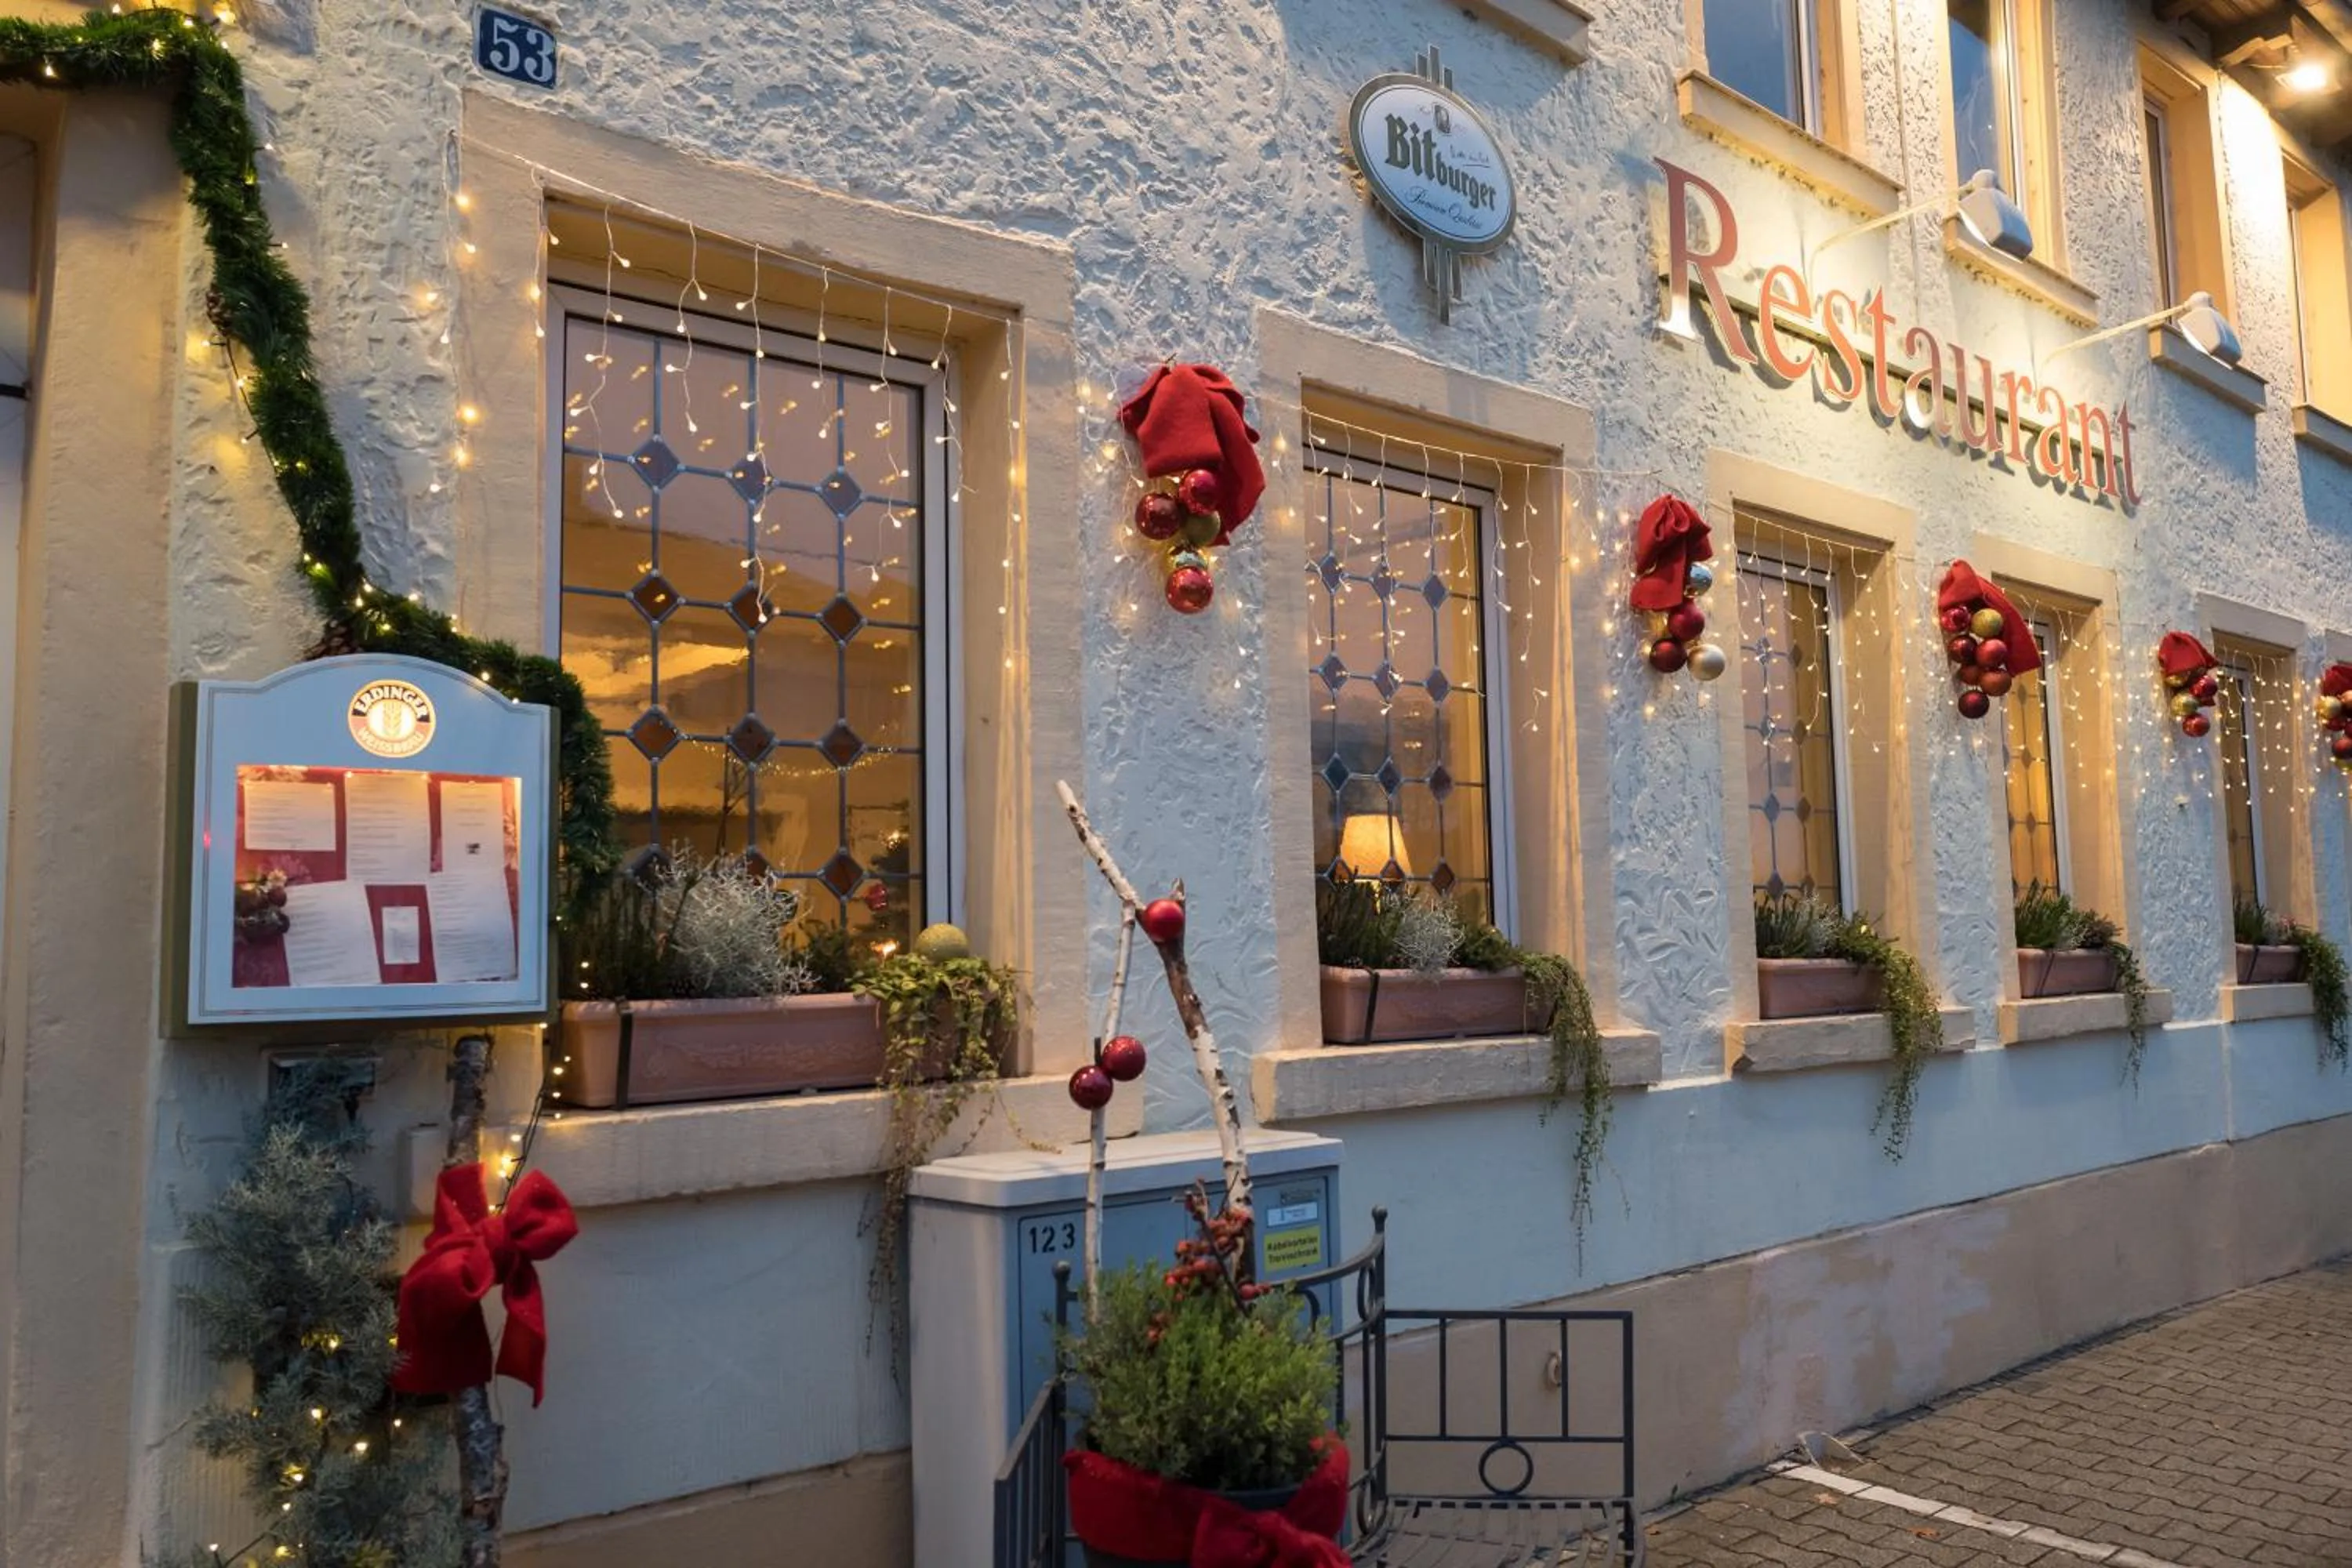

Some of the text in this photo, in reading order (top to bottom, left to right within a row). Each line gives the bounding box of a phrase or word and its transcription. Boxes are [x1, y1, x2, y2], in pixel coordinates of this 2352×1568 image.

[489, 16, 554, 82] 53
[1385, 112, 1497, 212] Bitburger
[1652, 155, 2143, 506] Restaurant
[354, 685, 429, 718] ERDINGER
[1029, 1222, 1076, 1254] 123
